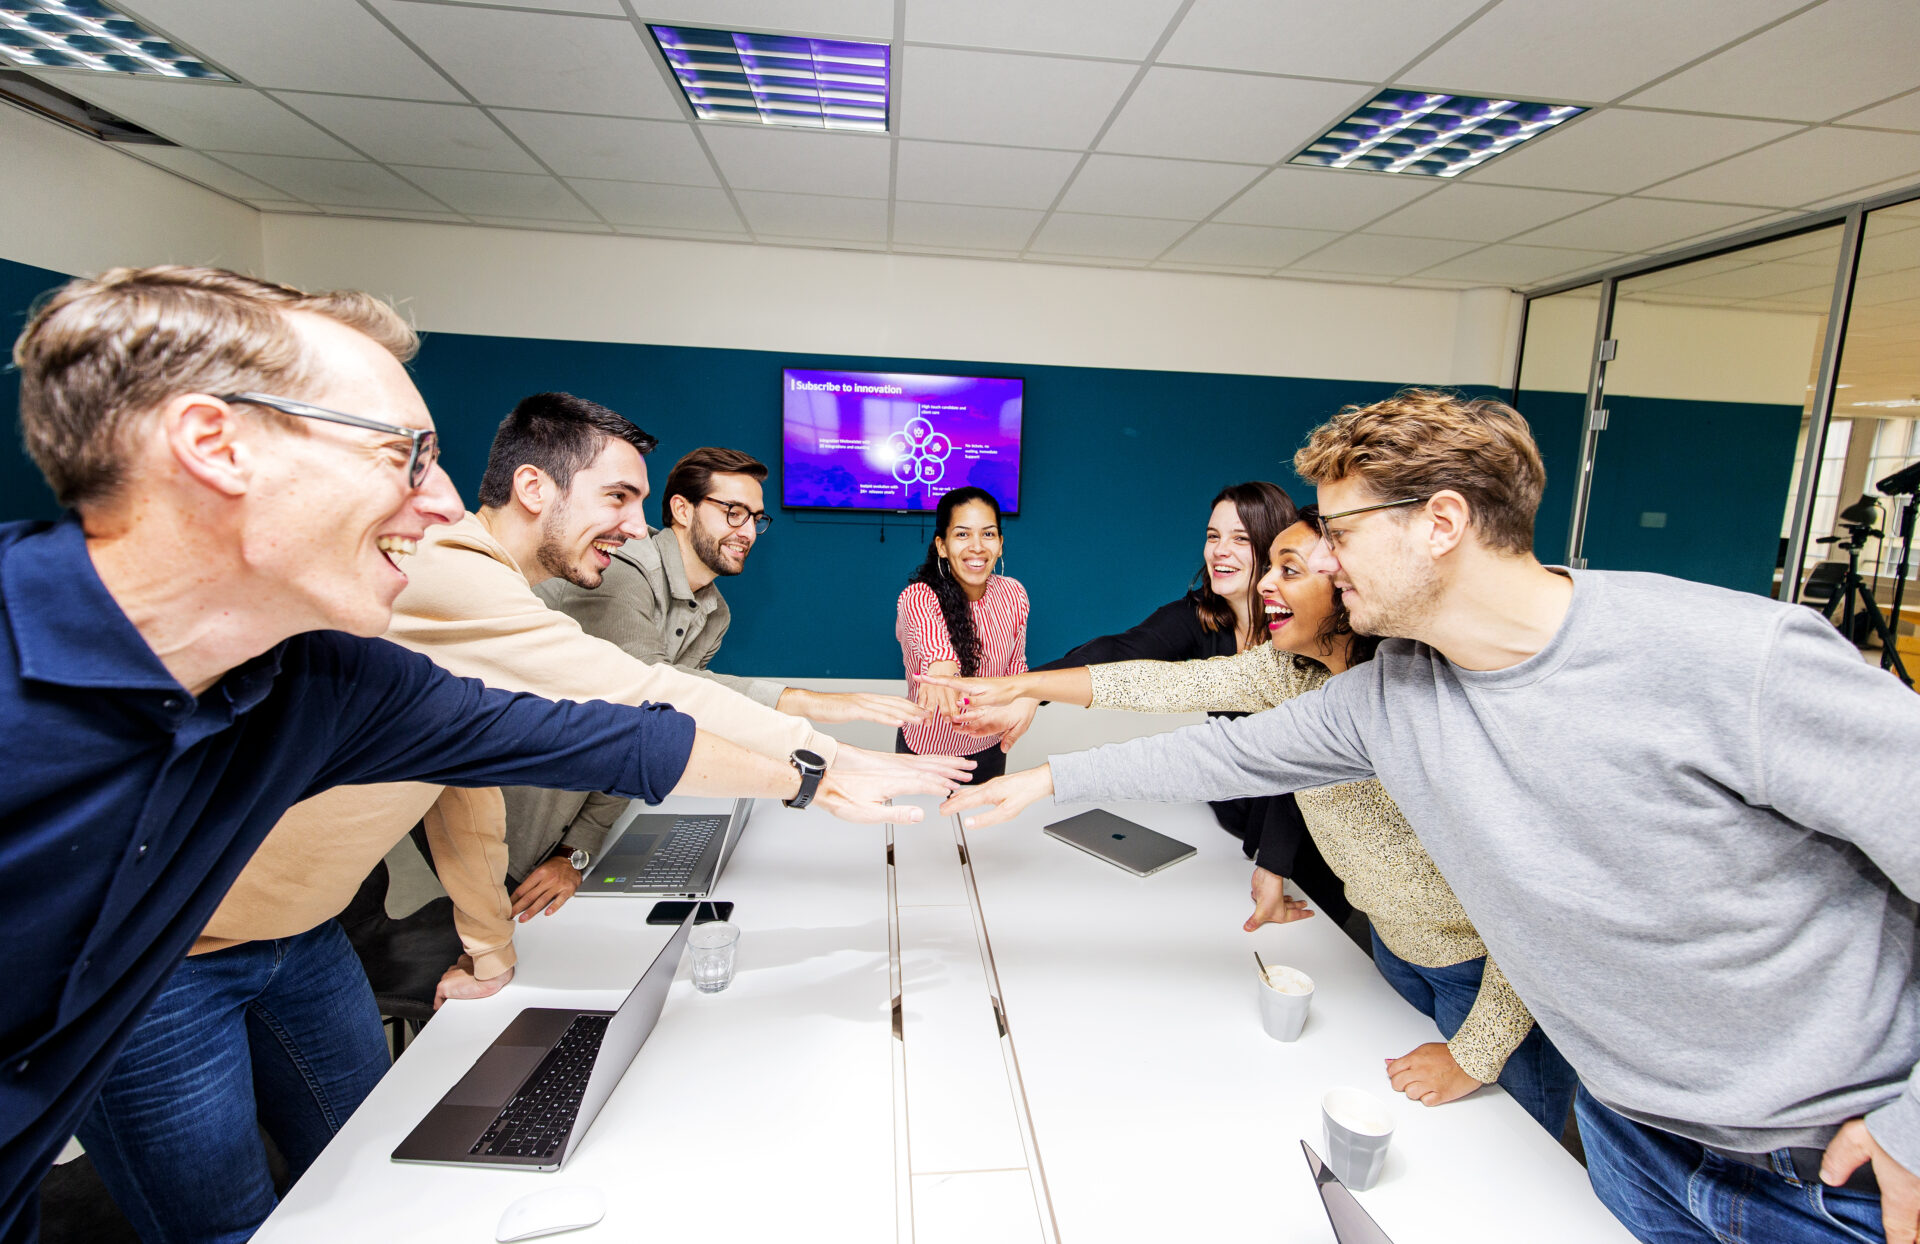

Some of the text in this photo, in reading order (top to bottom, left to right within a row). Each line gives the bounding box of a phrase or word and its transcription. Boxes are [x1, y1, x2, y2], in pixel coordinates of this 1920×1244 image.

[796, 380, 902, 394] Subscribe to innovation
